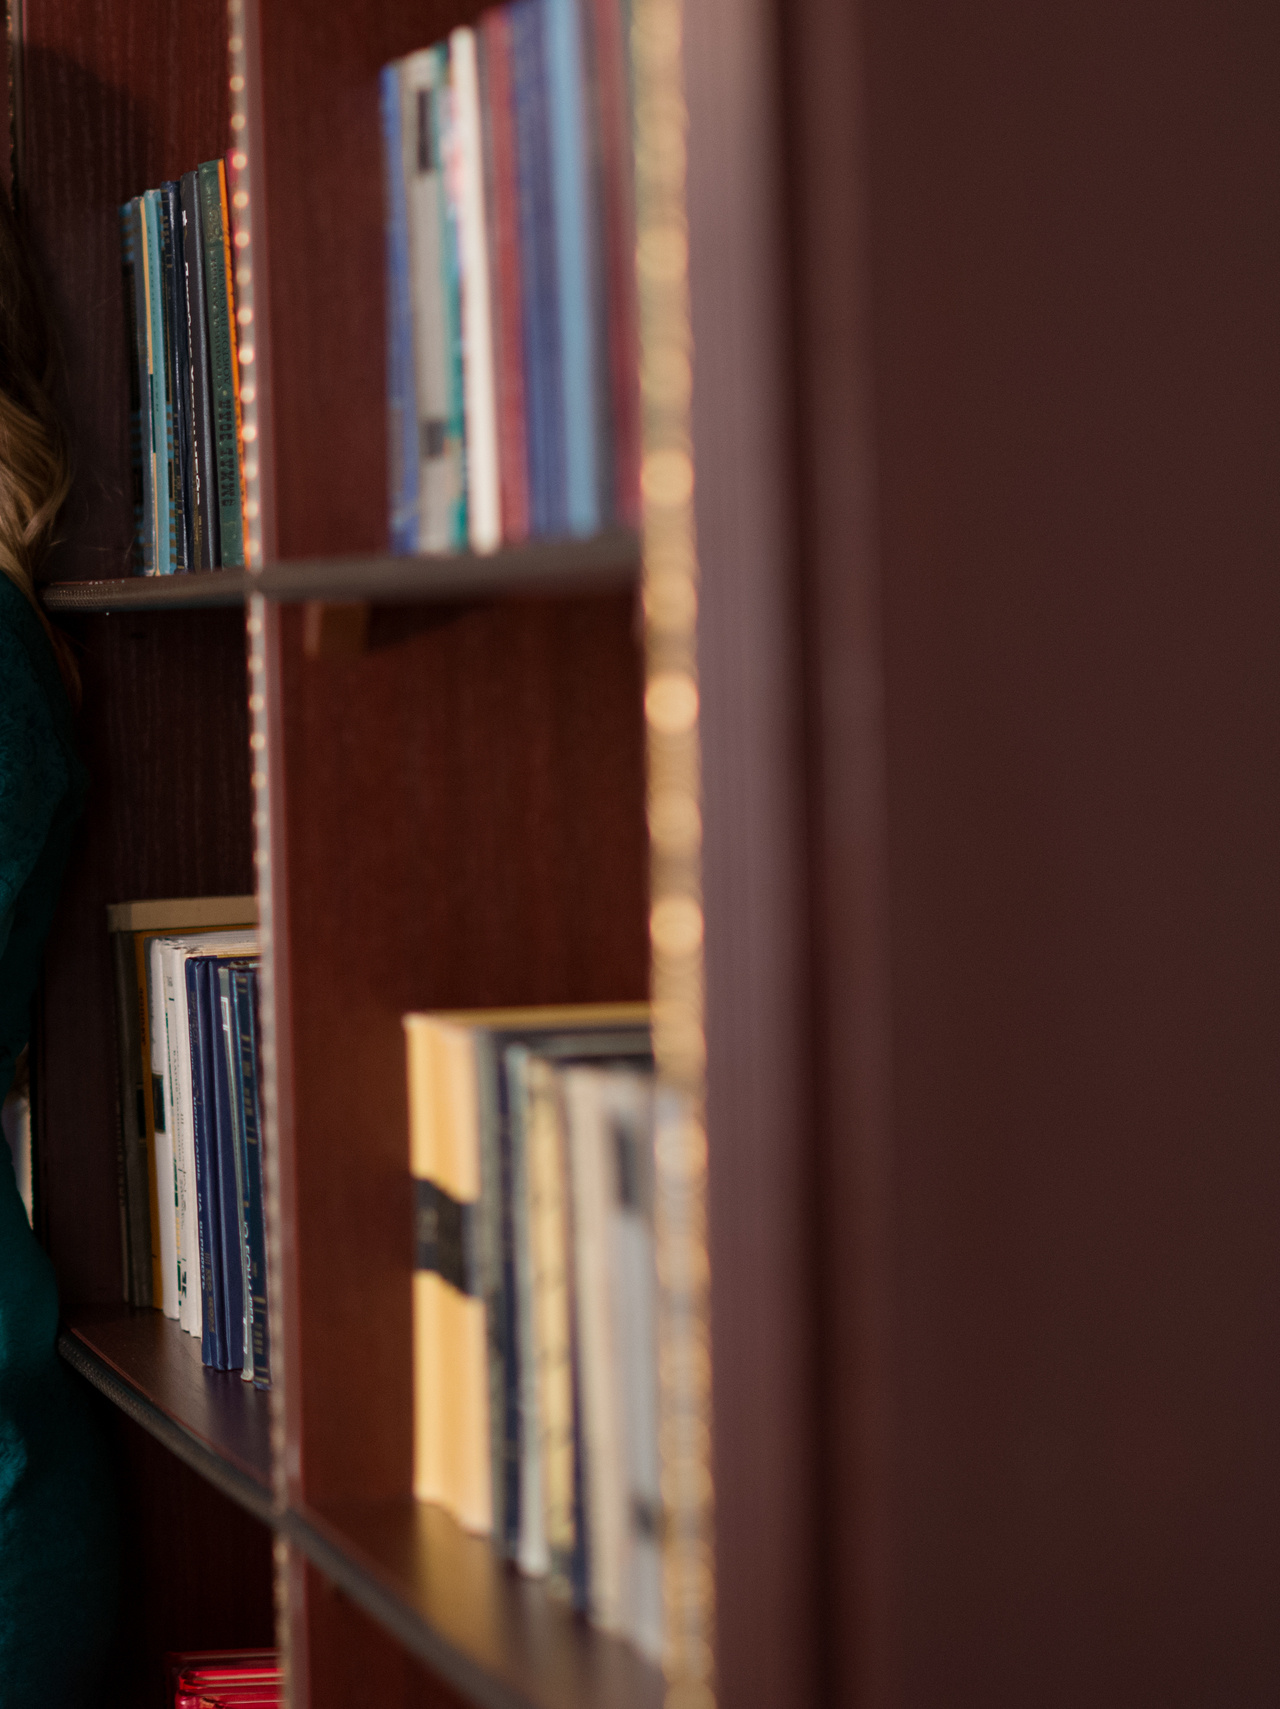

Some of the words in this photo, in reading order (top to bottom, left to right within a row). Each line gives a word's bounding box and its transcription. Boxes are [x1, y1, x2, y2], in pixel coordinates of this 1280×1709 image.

[218, 263, 228, 326] ПАСКАЛЬ
[221, 331, 231, 385] ДОКТОР
[219, 398, 232, 440] ЗОЛЯ
[220, 447, 234, 507] ЭМИЛЬ
